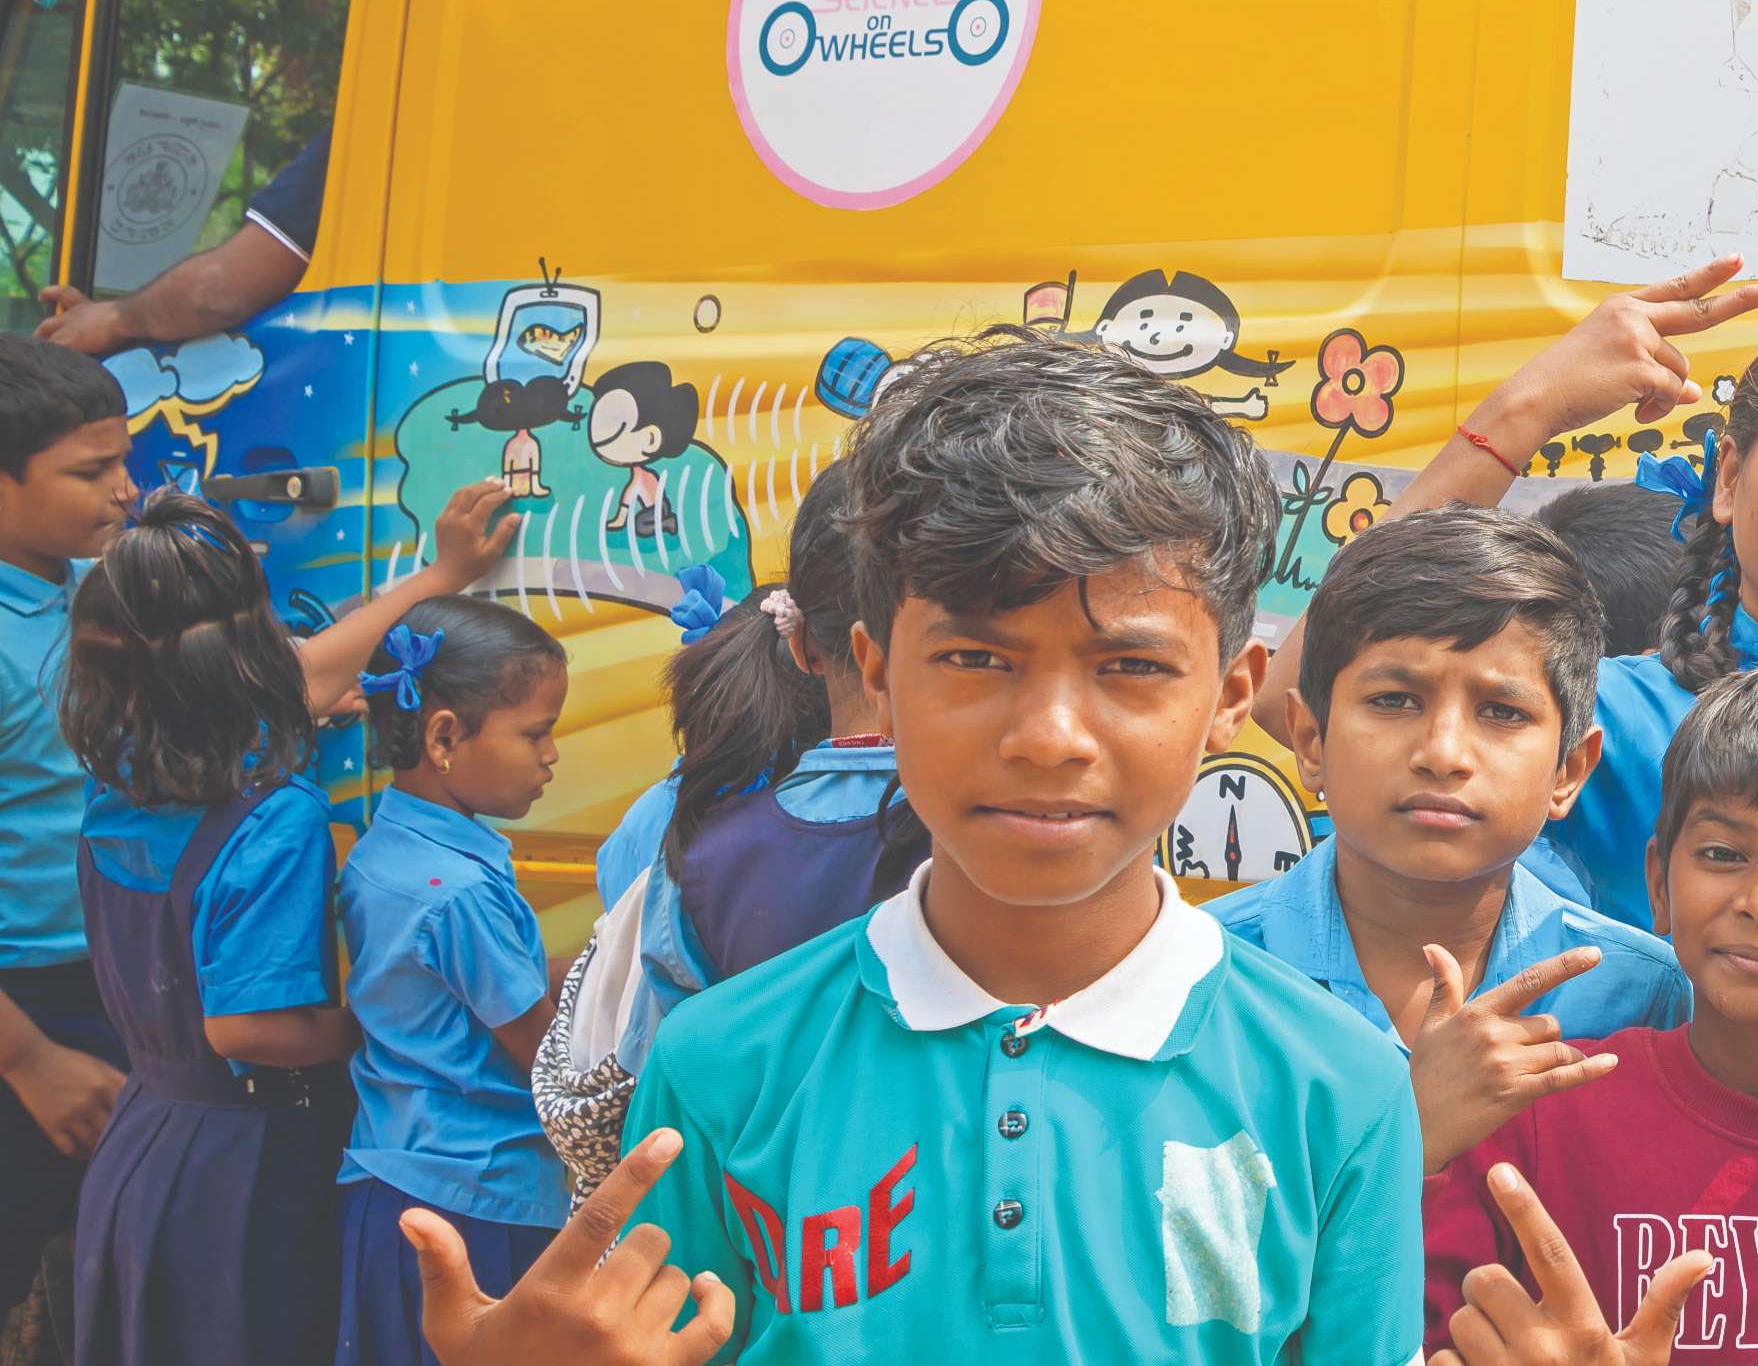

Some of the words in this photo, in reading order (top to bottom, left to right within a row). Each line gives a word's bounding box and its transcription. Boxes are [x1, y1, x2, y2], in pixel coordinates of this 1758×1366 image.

[866, 13, 892, 32] on
[816, 28, 949, 63] WHEELS
[1219, 774, 1246, 801] N
